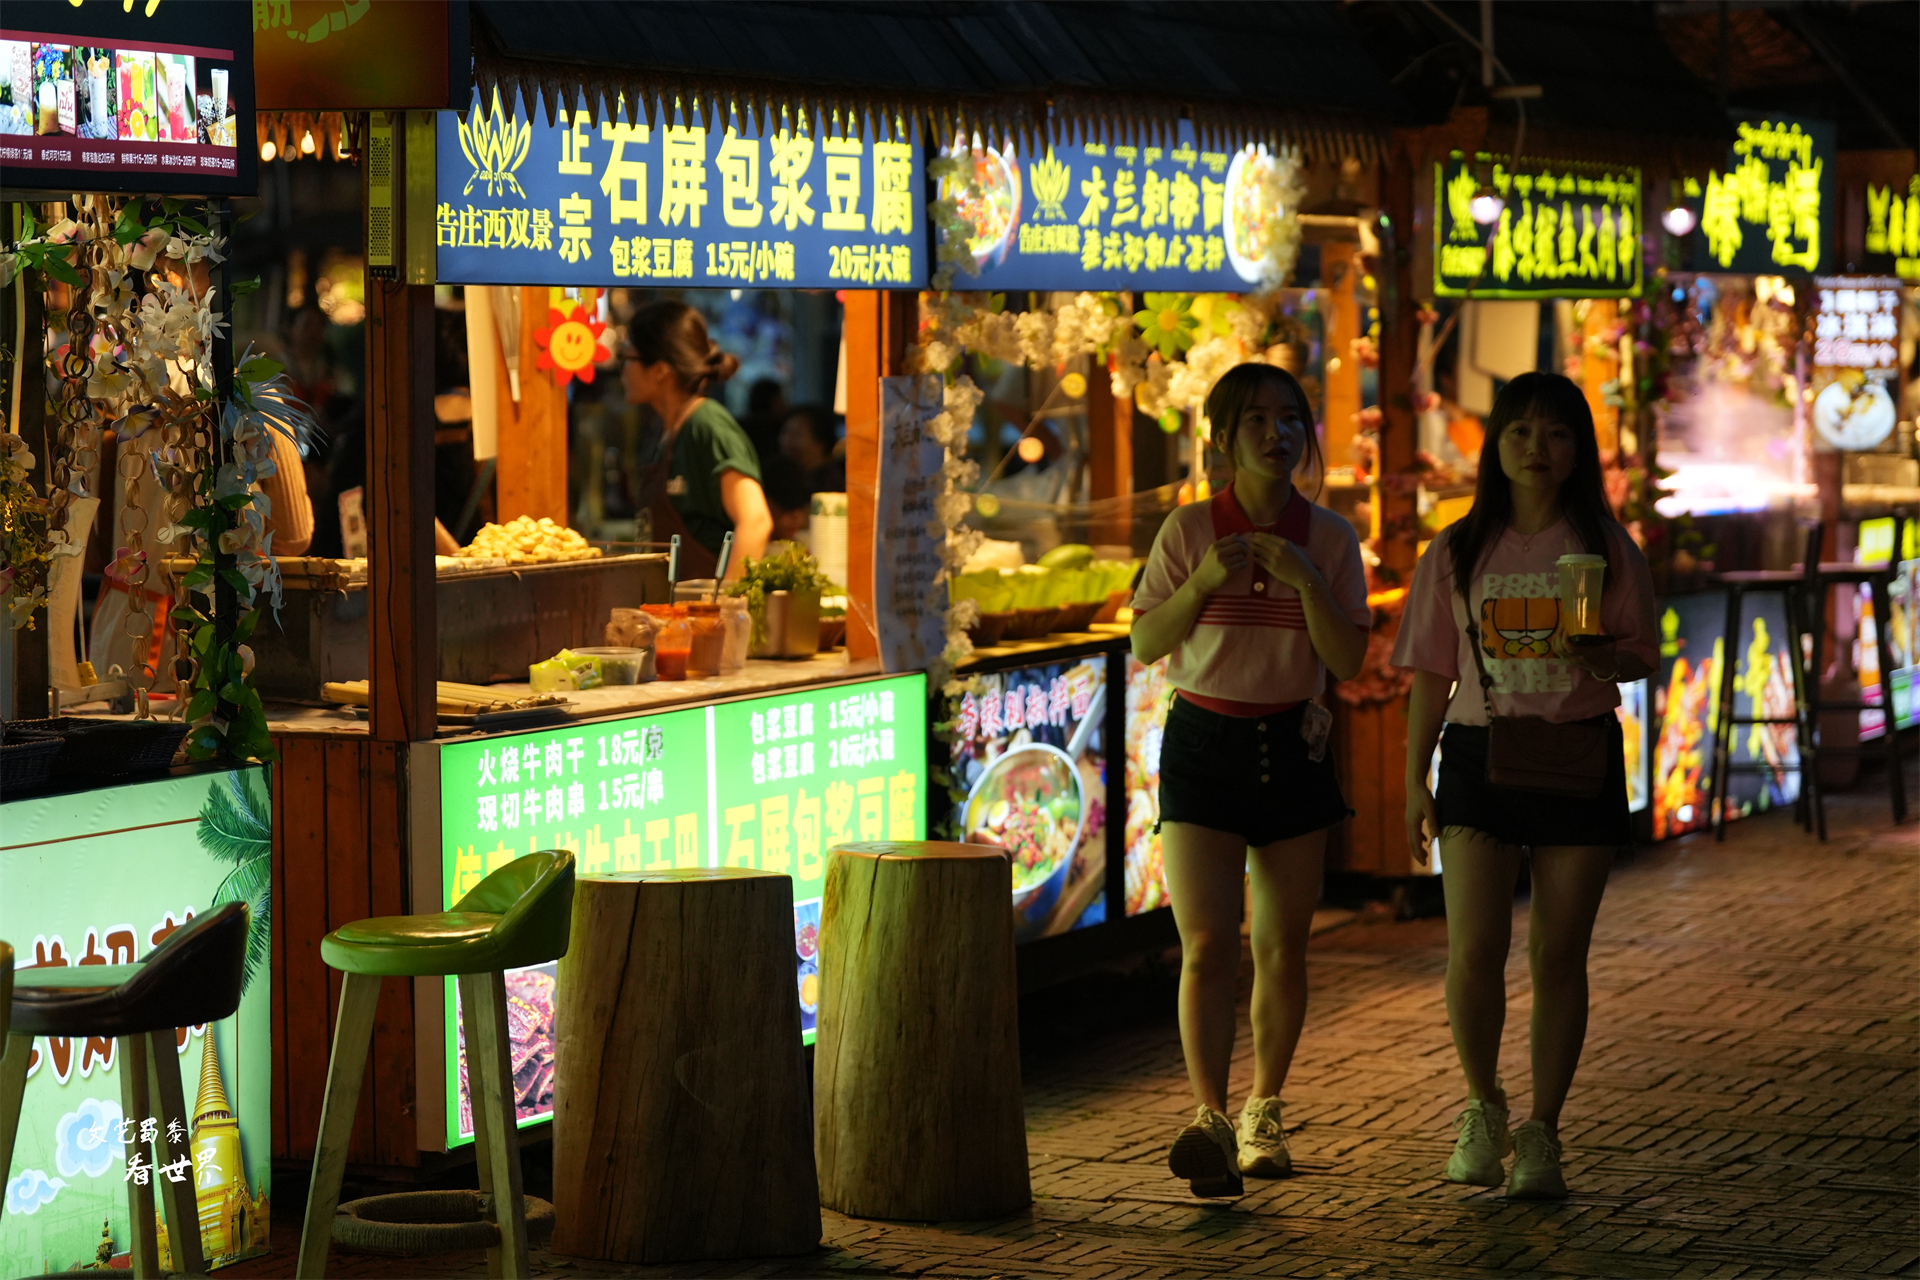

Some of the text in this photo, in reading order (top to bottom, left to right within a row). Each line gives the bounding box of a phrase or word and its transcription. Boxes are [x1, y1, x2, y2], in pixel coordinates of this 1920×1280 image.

[558, 109, 593, 264] 正宗
[600, 122, 914, 236] 石屏包浆豆腐
[610, 235, 912, 285] 包浆豆腐 15元/小碗 20元/大碗
[750, 689, 895, 745] 包浆豆腐 15元/小碗
[477, 736, 585, 788] 火烧牛肉干
[751, 728, 895, 785] 包浆豆腐 20元/大碗
[477, 767, 664, 833] 现切牛肉串 15元/串
[724, 769, 916, 881] 石屏包浆豆腐
